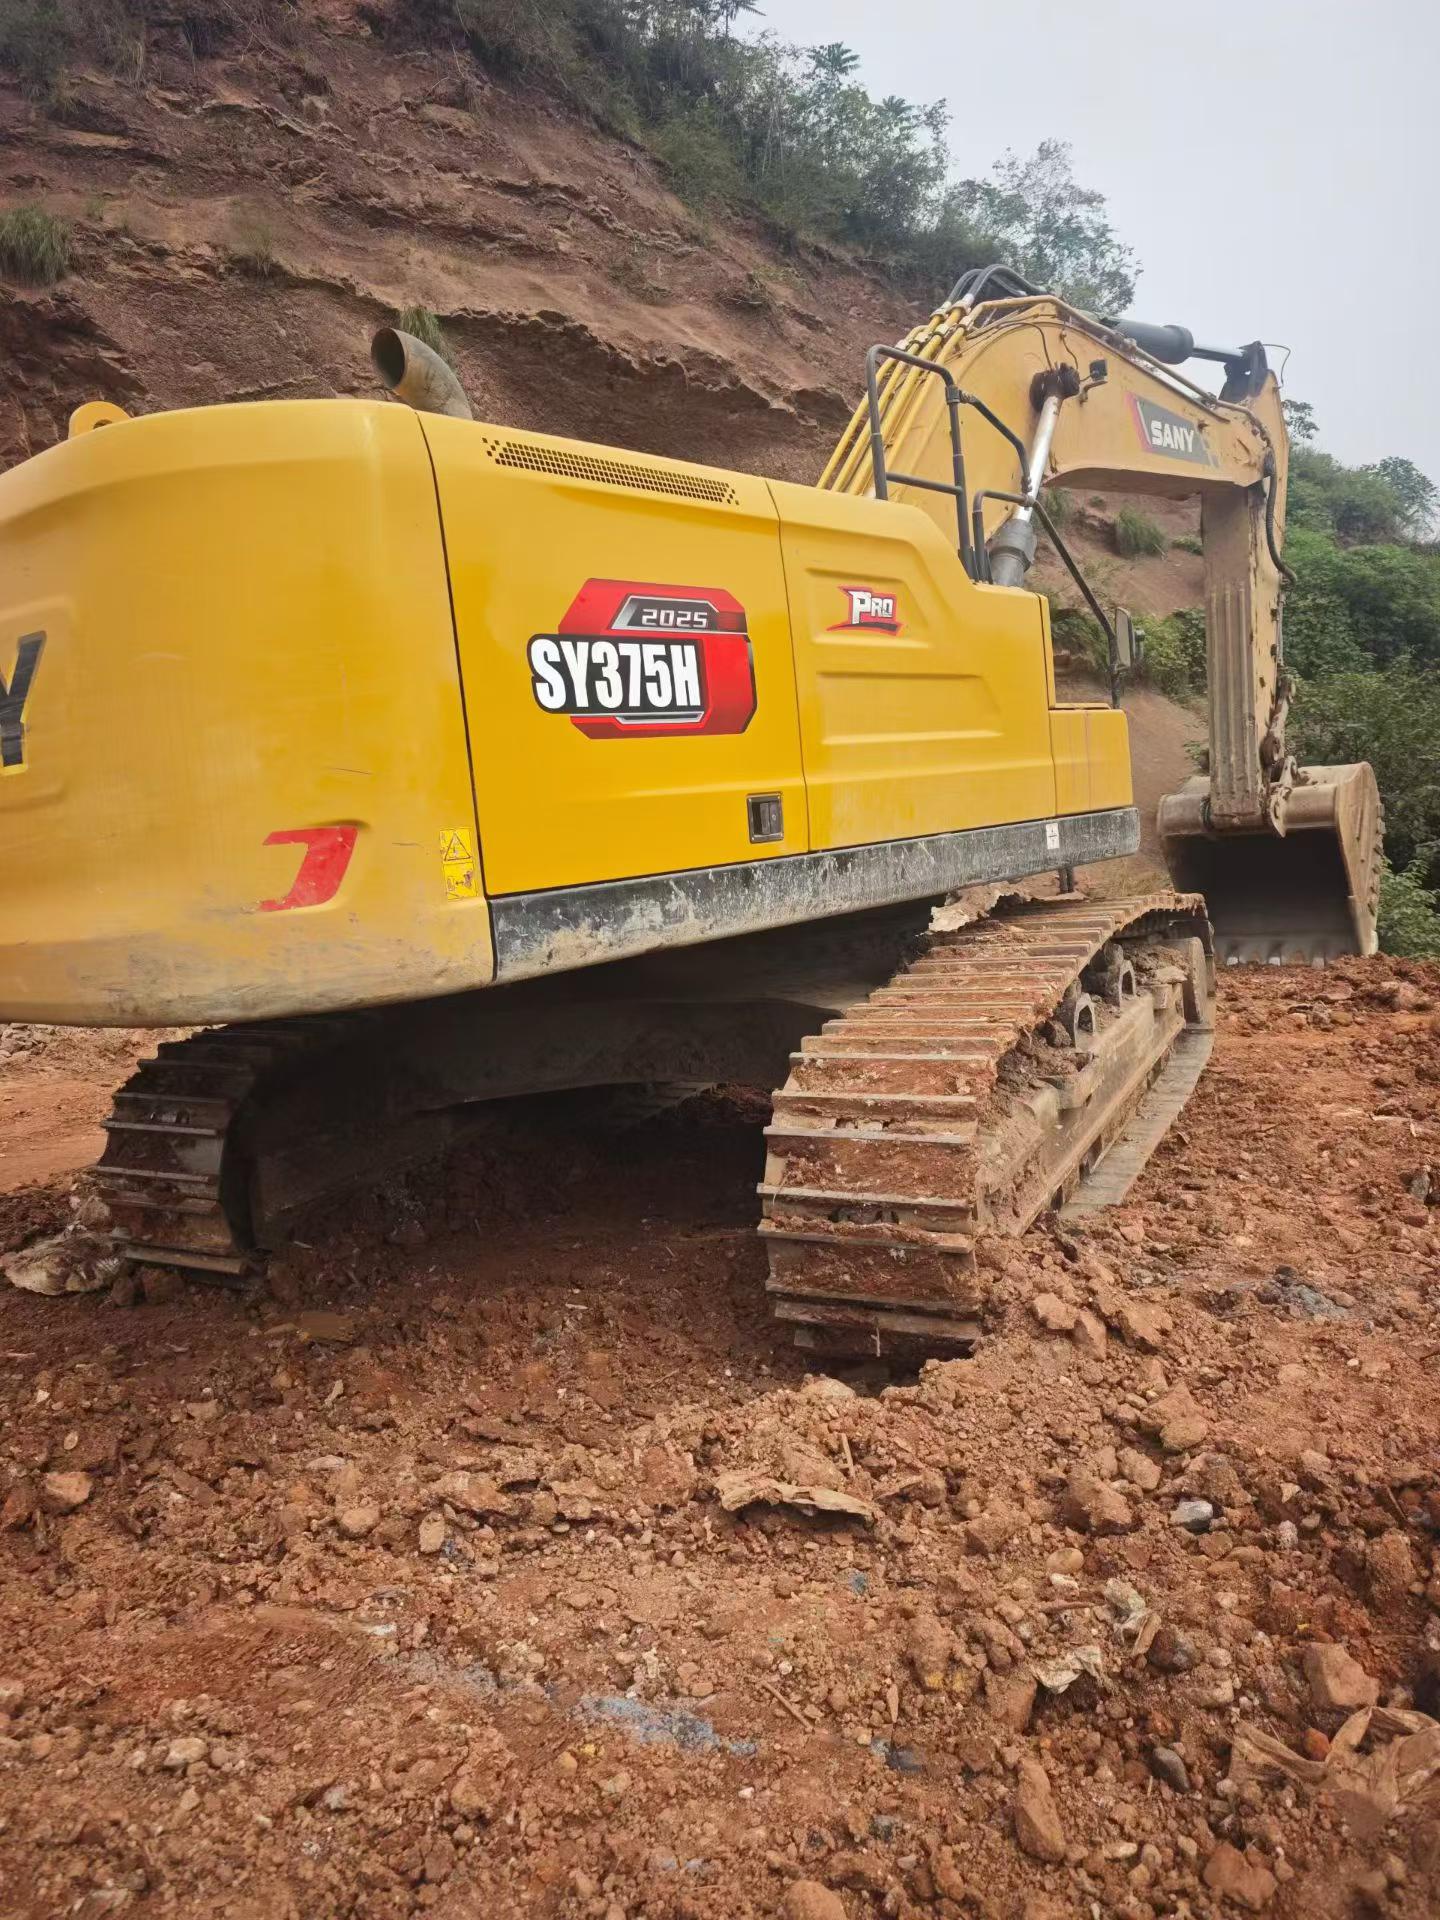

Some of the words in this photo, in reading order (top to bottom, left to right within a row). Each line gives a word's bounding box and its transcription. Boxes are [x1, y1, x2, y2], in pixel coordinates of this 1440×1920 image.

[1151, 420, 1194, 453] SANY
[641, 608, 708, 628] 2025
[530, 638, 701, 709] SY375H
